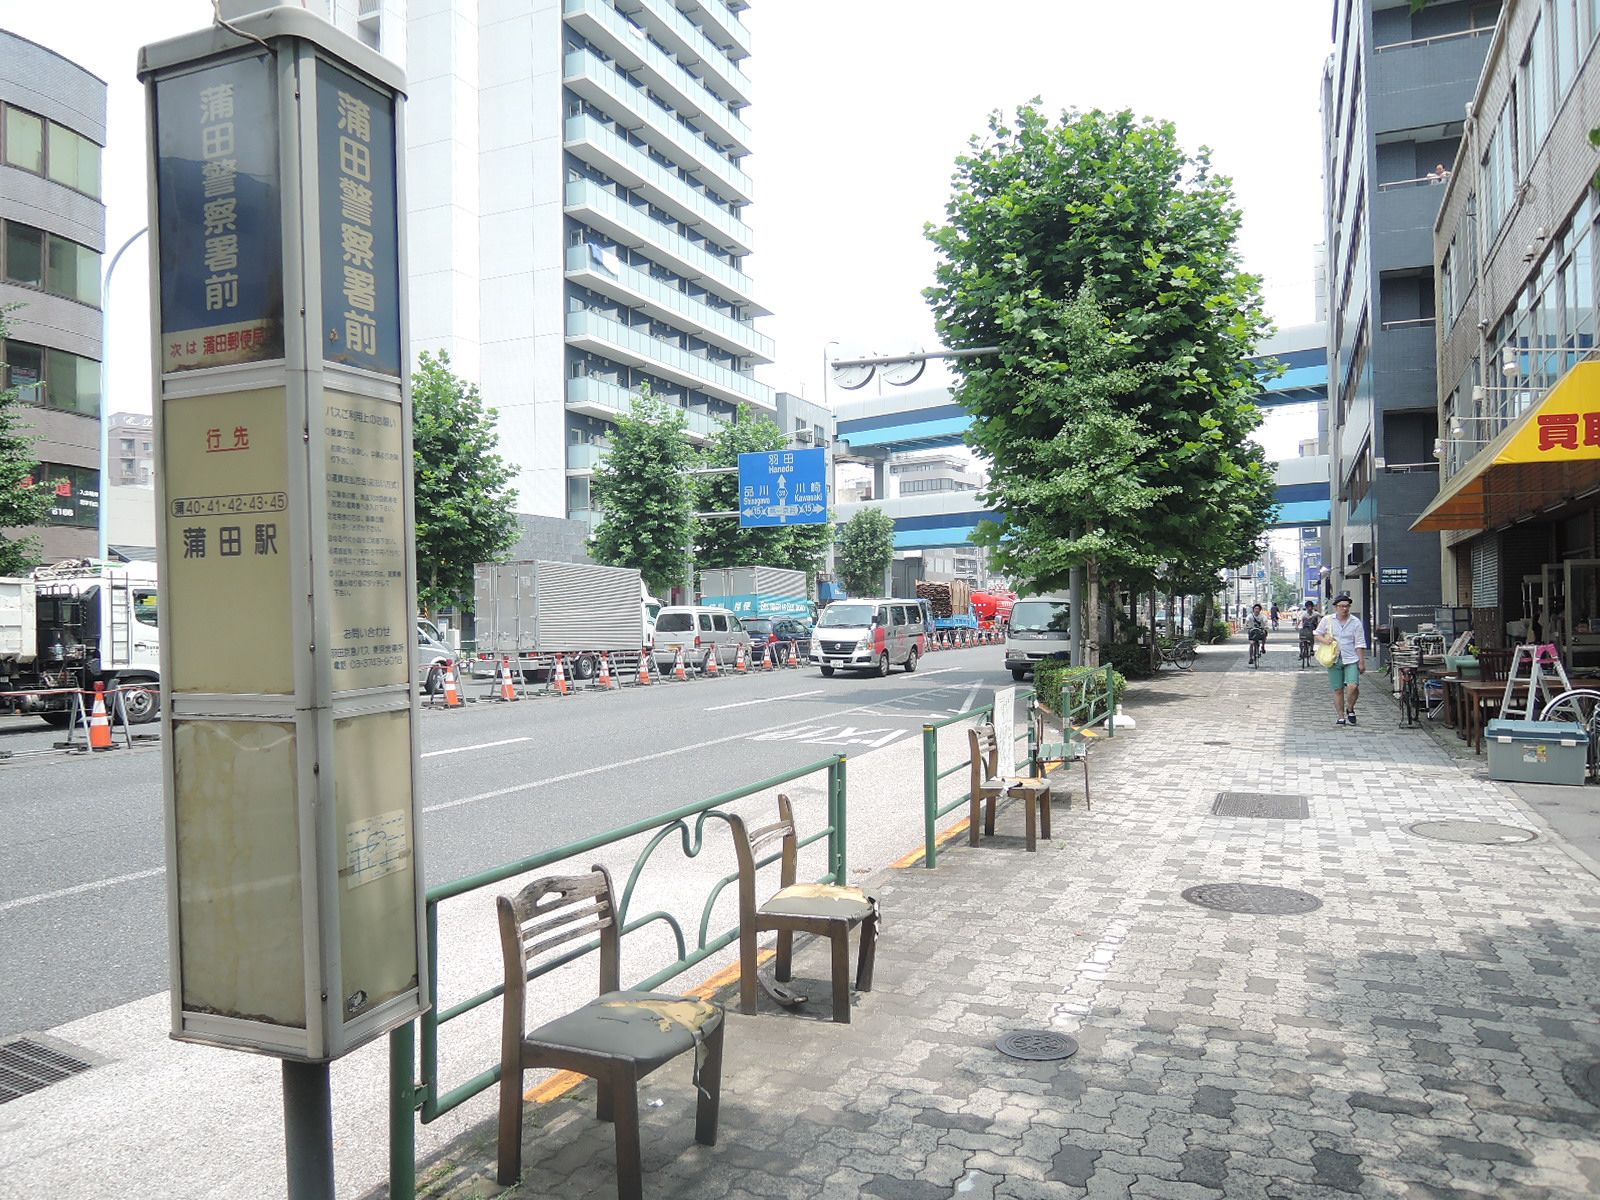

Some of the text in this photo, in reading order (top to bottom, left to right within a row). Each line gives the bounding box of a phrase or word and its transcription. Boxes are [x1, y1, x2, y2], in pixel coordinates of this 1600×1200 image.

[199, 82, 240, 312] 蒲田警察署前
[336, 90, 377, 357] 蒲田警察署前
[170, 326, 266, 358] 次は 蒲田郵便局
[206, 425, 250, 449] 行先
[768, 453, 794, 465] 羽田
[768, 465, 794, 474] Haneda
[744, 485, 769, 497] 品川
[795, 482, 821, 493] 川崎
[794, 493, 823, 502] Kawasaki
[183, 523, 278, 559] 蒲田駅
[343, 626, 391, 640] お問い合わせ
